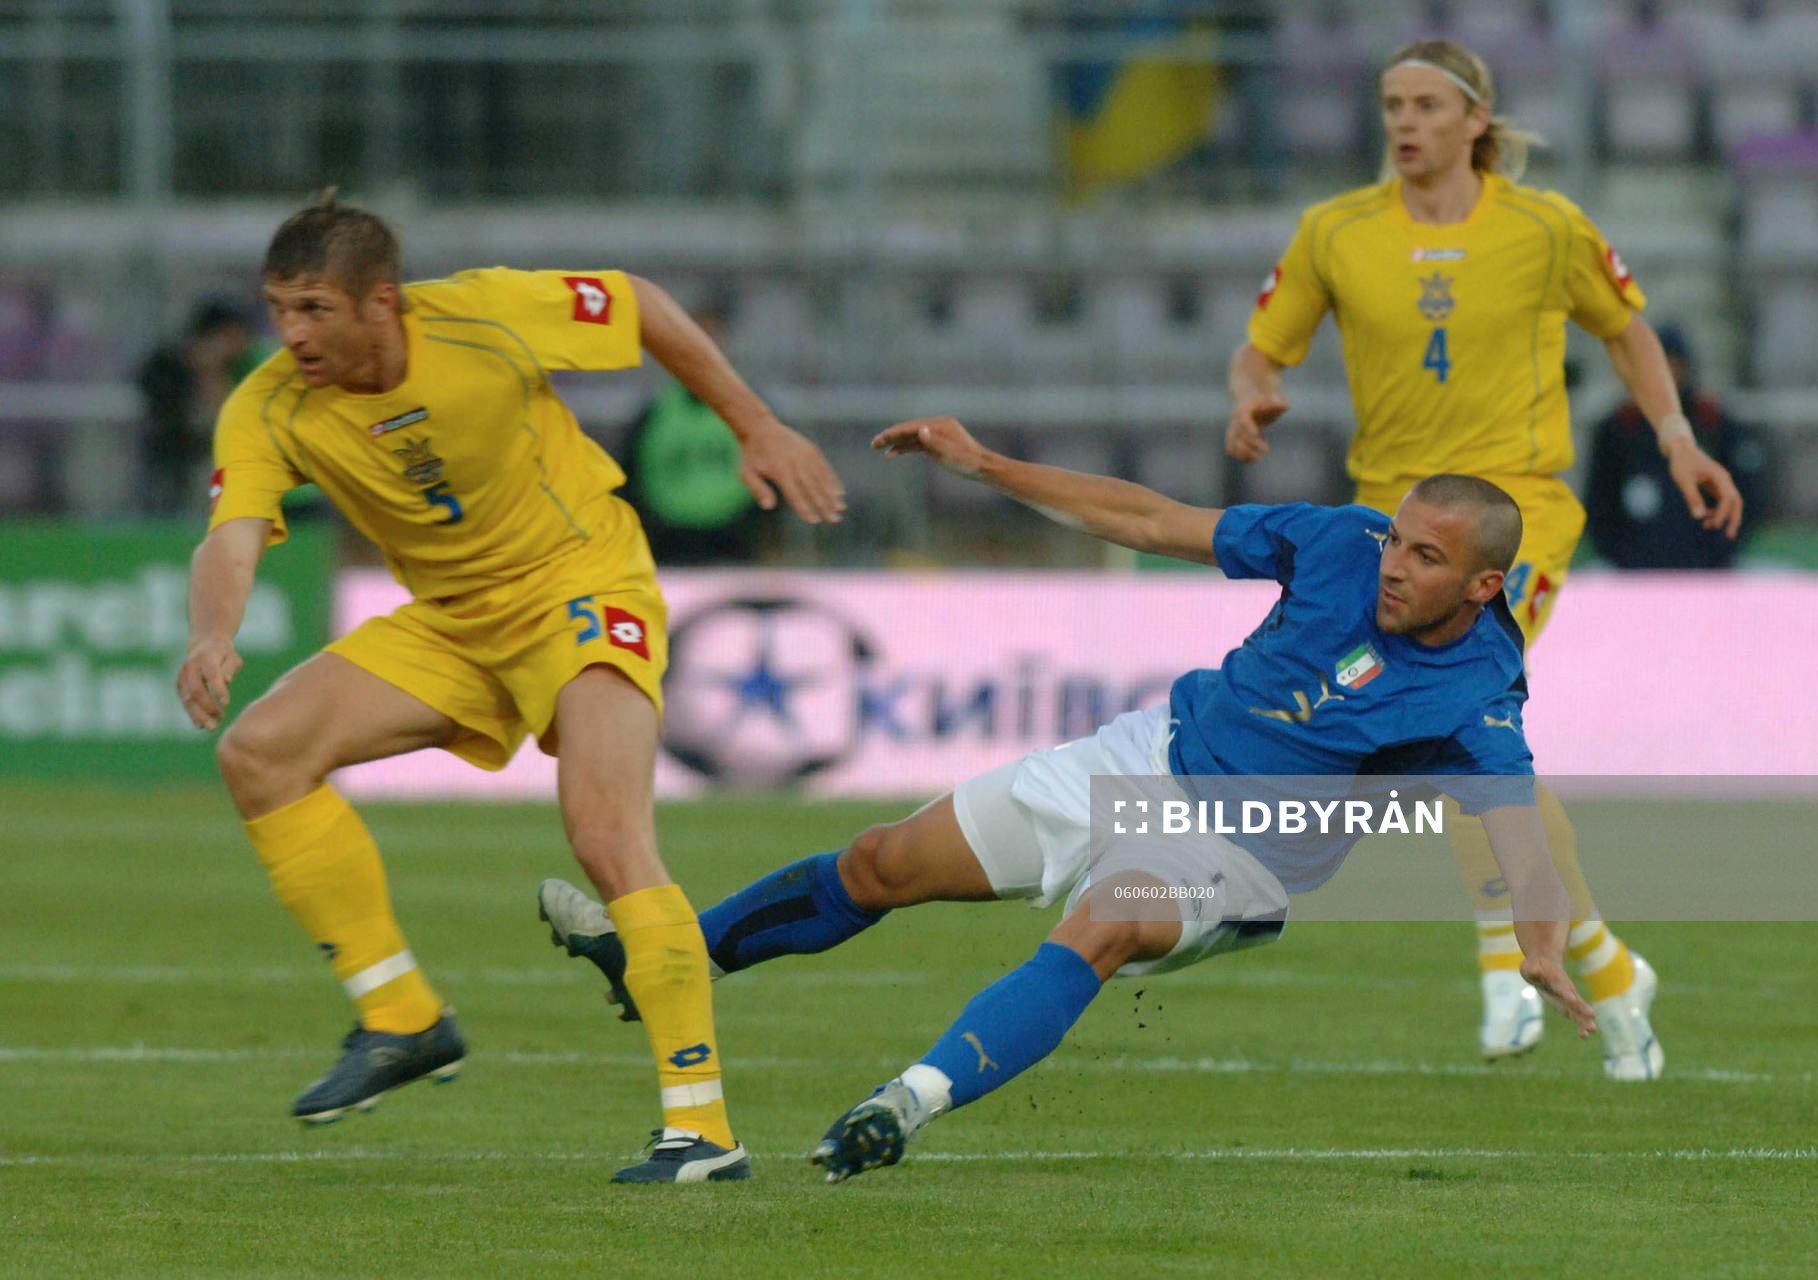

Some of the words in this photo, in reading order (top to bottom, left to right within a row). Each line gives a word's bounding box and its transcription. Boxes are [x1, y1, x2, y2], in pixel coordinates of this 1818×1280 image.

[1423, 328, 1451, 383] 4
[424, 480, 463, 525] 5
[1503, 562, 1532, 608] 4
[567, 596, 602, 646] 5
